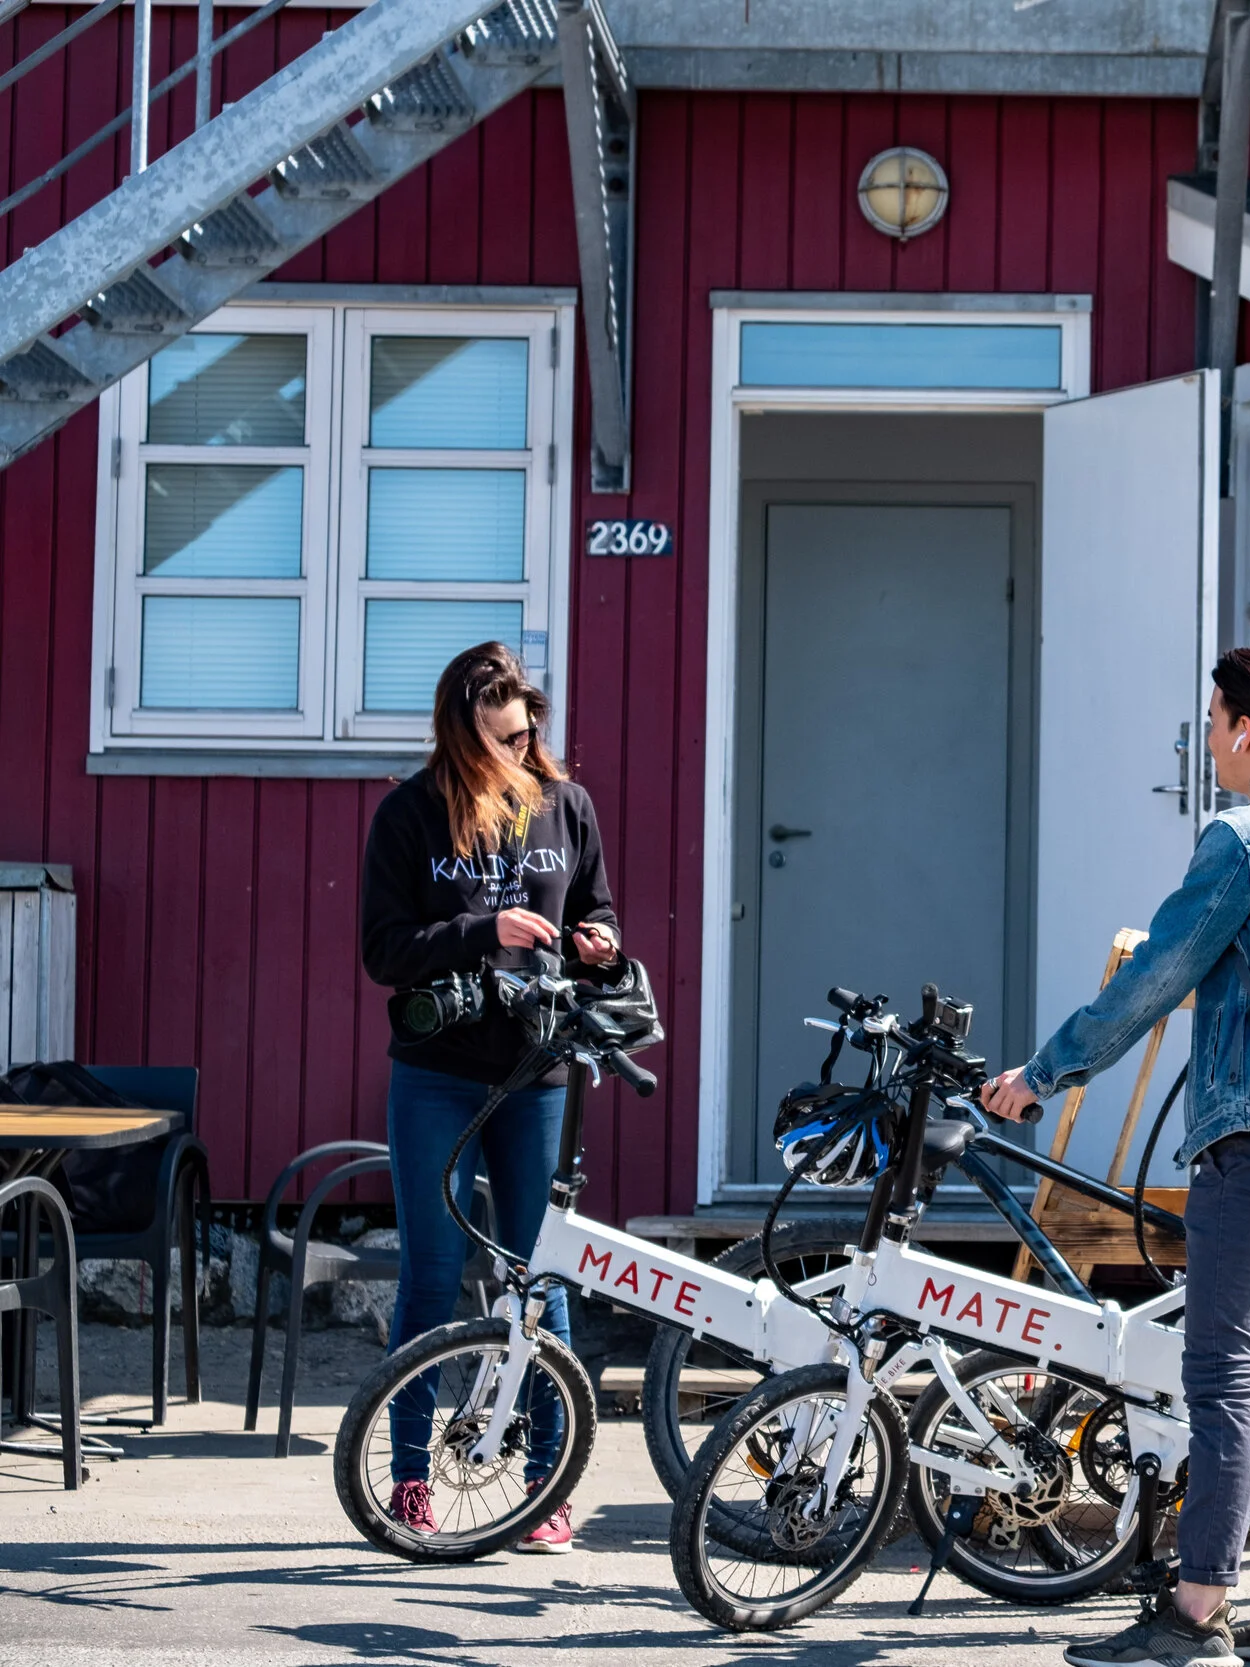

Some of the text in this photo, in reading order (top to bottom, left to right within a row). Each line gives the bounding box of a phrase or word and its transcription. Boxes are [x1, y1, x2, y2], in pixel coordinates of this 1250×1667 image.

[590, 521, 668, 555] 2369
[578, 1243, 712, 1323] MATE.
[917, 1277, 1062, 1351] MATE.
